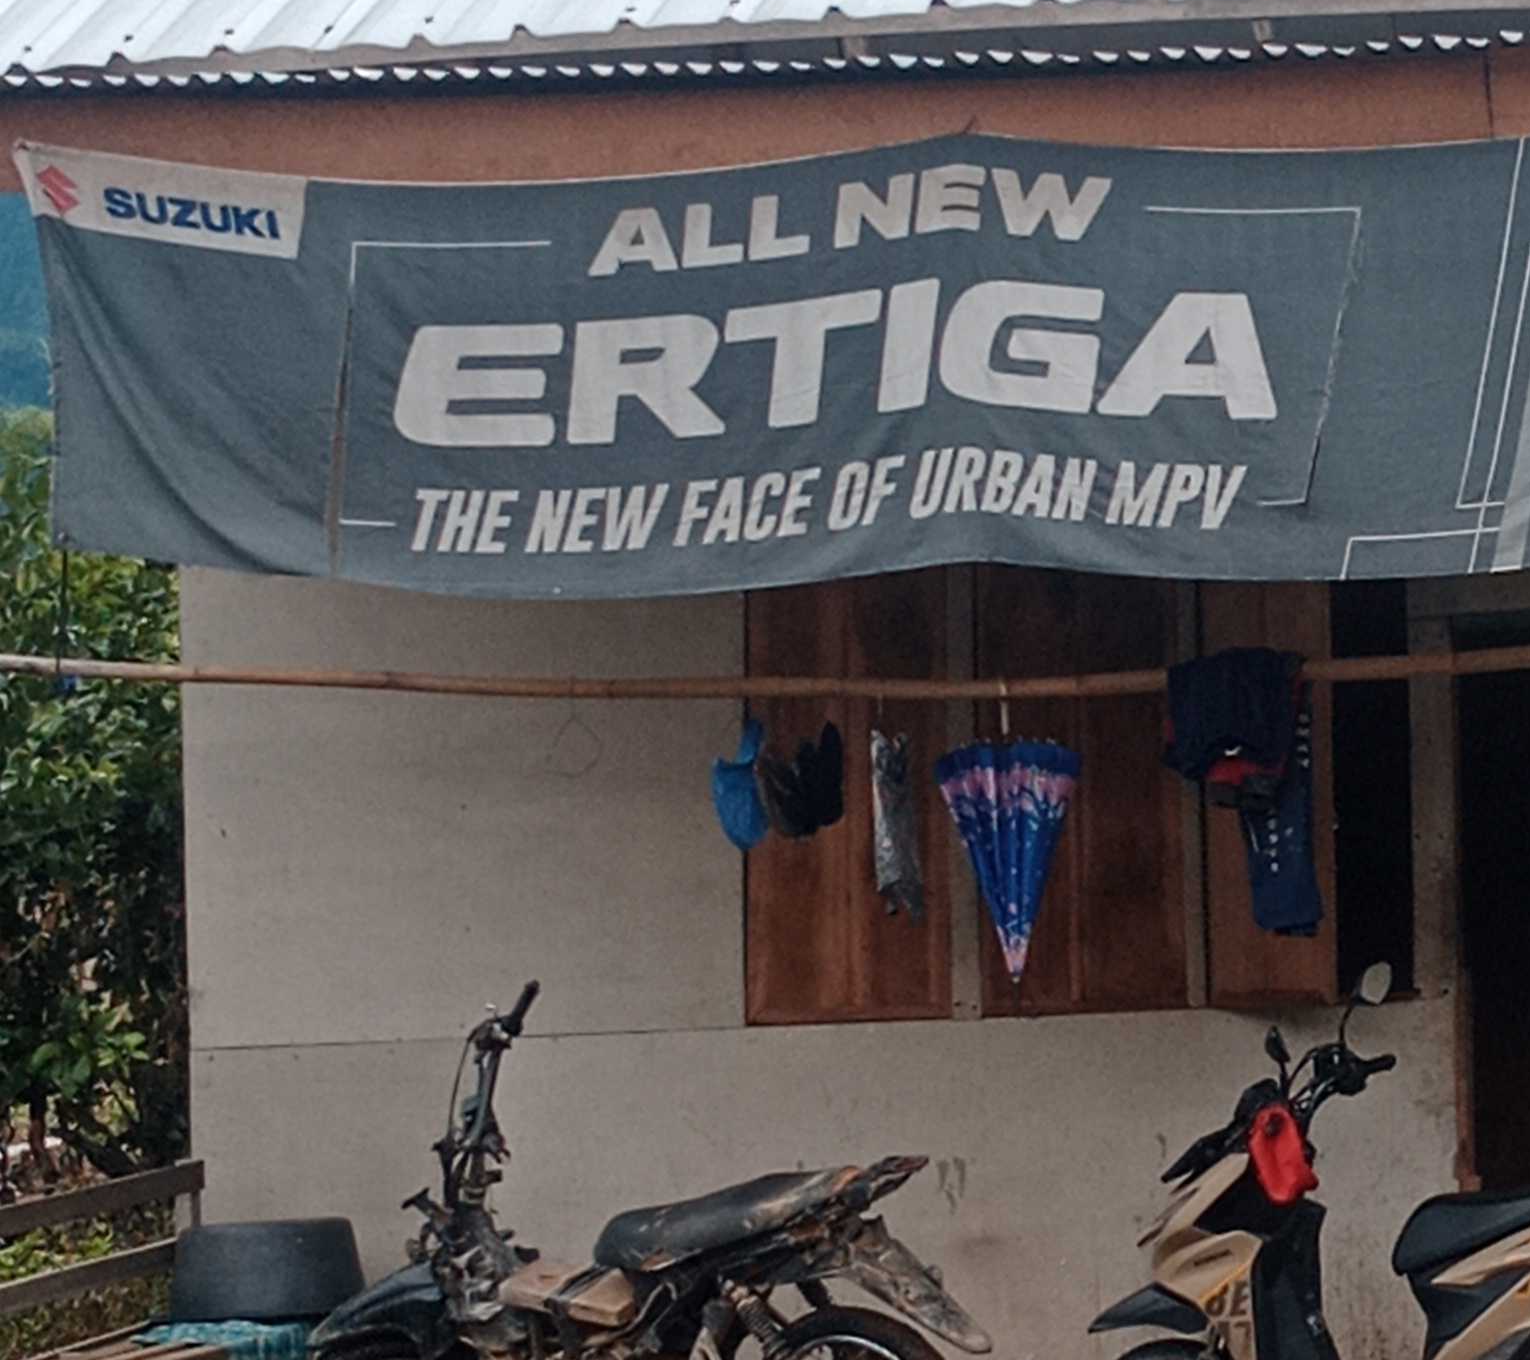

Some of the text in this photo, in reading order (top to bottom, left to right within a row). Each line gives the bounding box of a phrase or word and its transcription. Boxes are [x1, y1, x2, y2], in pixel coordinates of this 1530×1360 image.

[103, 186, 281, 240] SUZUKI
[587, 162, 1113, 277] ALL NEW
[393, 277, 1278, 448] ERTIGA
[410, 445, 1249, 554] THE NEW FACE OF URBAN MPV
